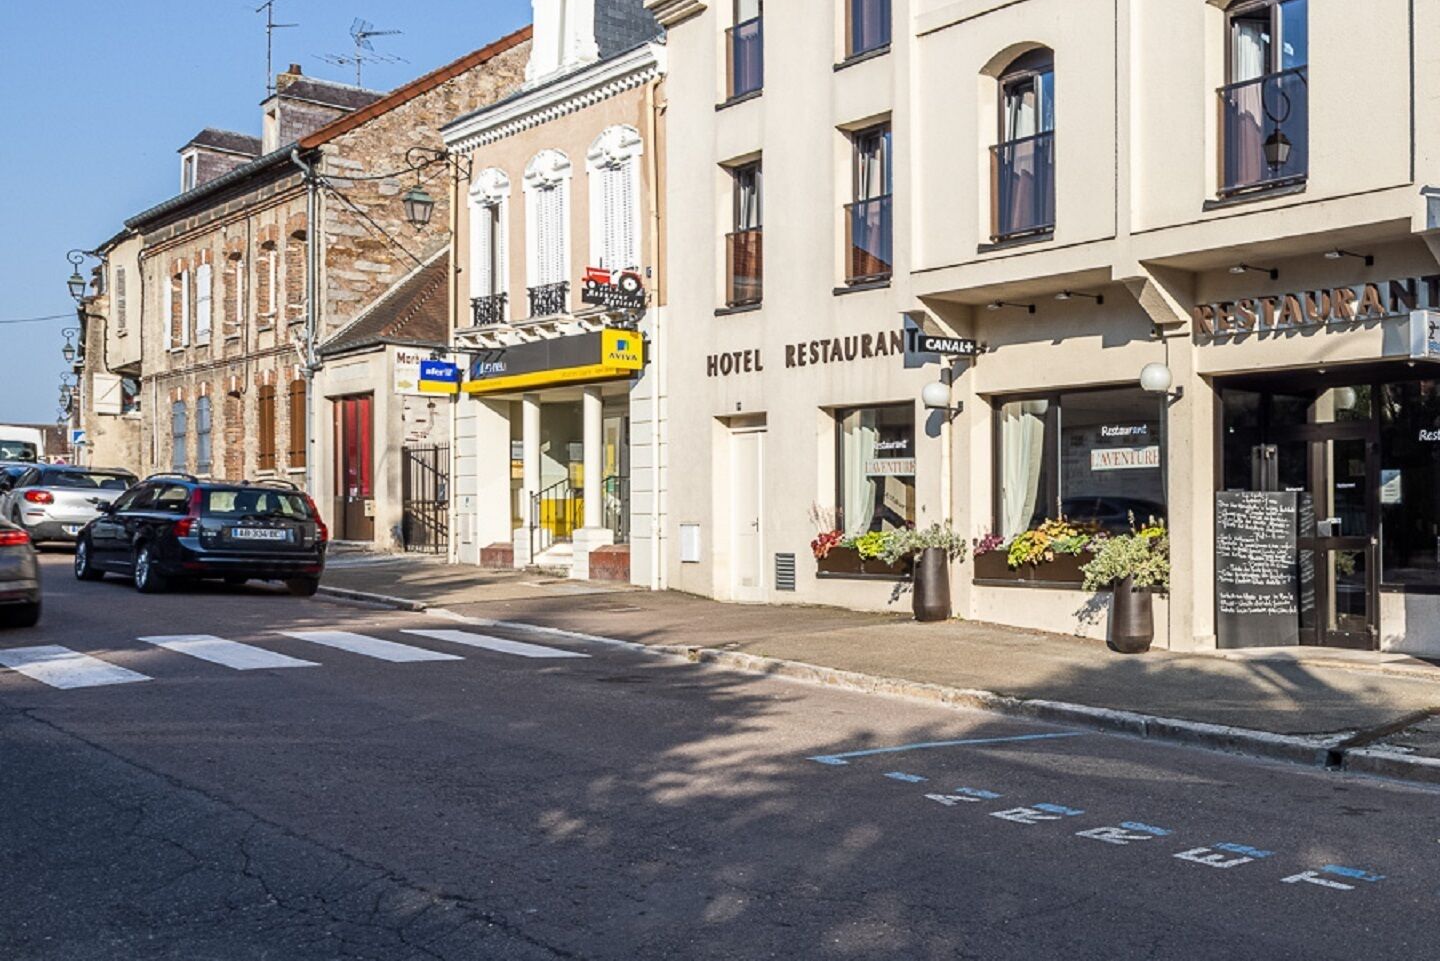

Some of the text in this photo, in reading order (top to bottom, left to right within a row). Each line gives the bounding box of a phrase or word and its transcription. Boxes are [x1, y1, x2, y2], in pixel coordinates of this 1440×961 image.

[706, 328, 918, 377] HOTEL RESTAURANT
[925, 339, 974, 353] CANAL+
[609, 352, 638, 361] AVIVA
[1101, 424, 1147, 437] Restaurant
